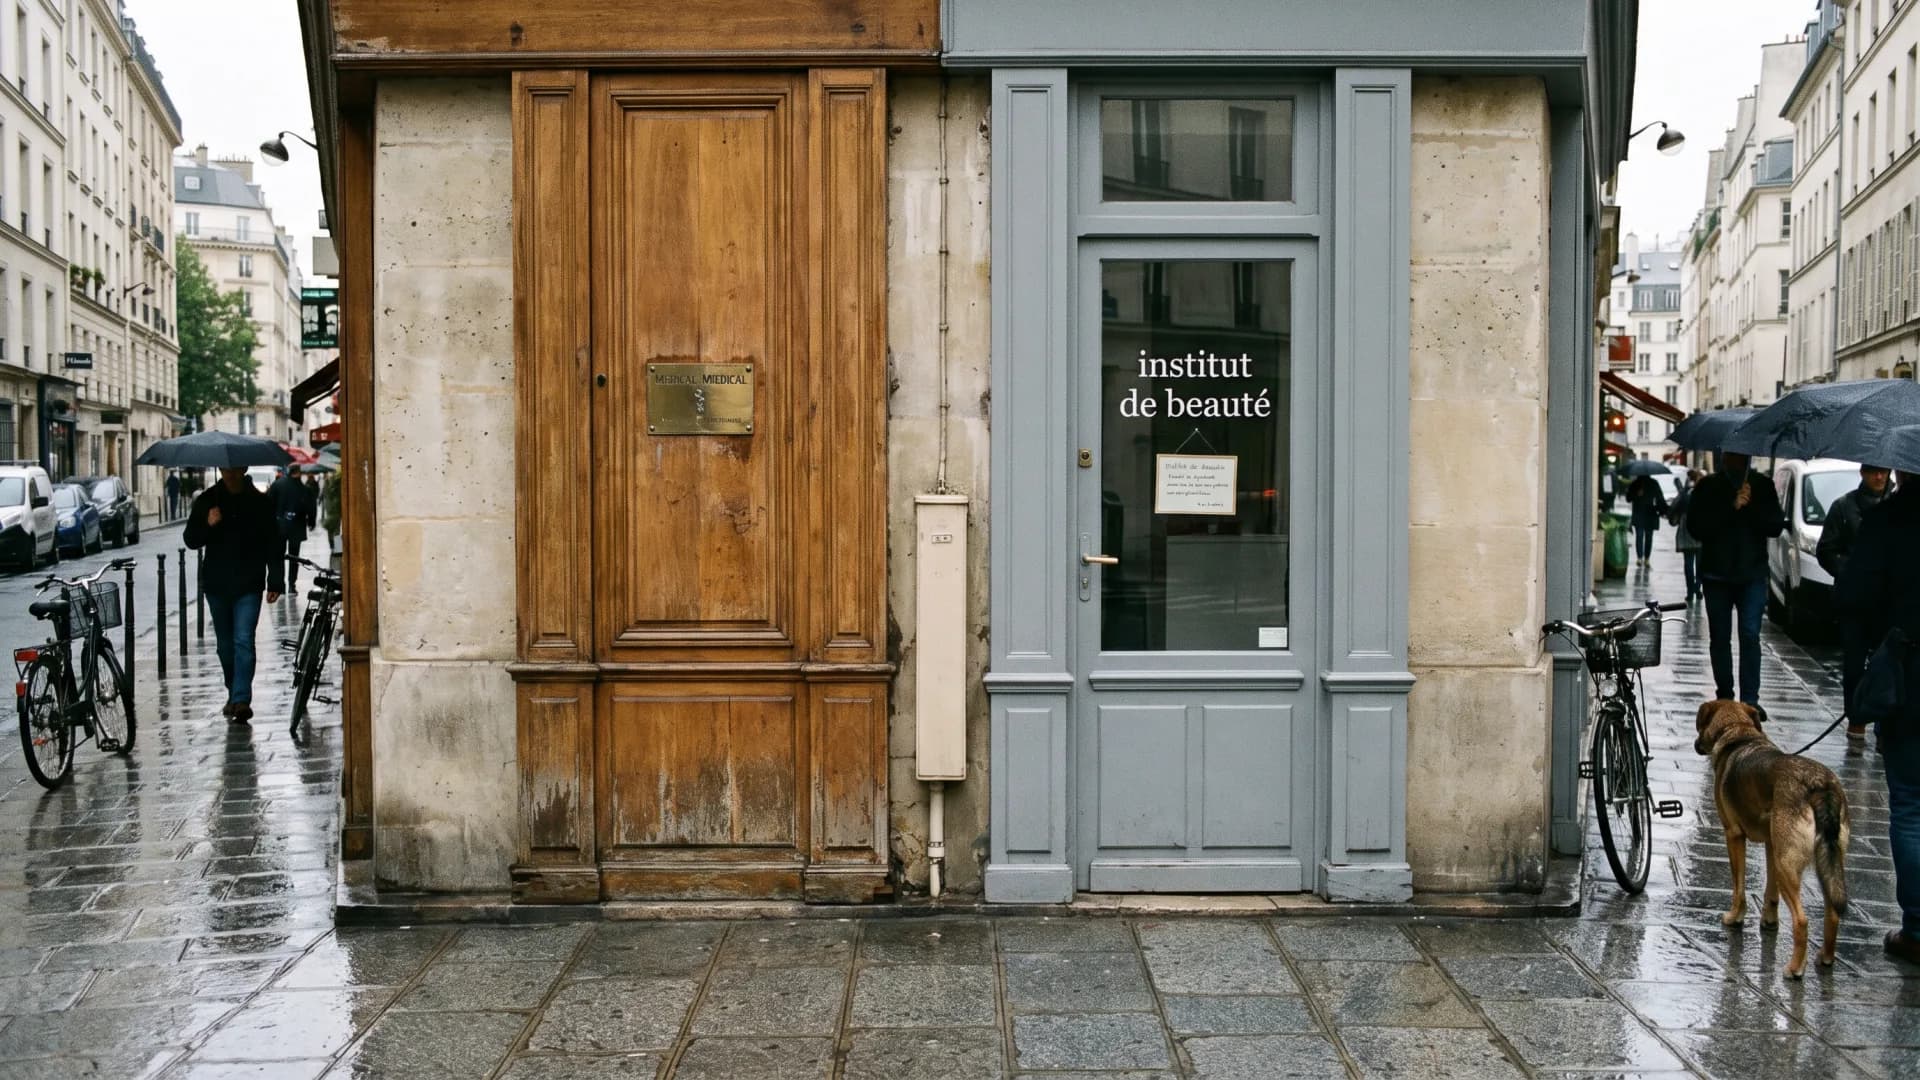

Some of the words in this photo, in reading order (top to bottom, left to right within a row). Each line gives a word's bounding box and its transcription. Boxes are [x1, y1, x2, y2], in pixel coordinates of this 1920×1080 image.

[1138, 350, 1253, 378] institut
[1119, 388, 1157, 418] de
[1164, 388, 1271, 418] beauté
